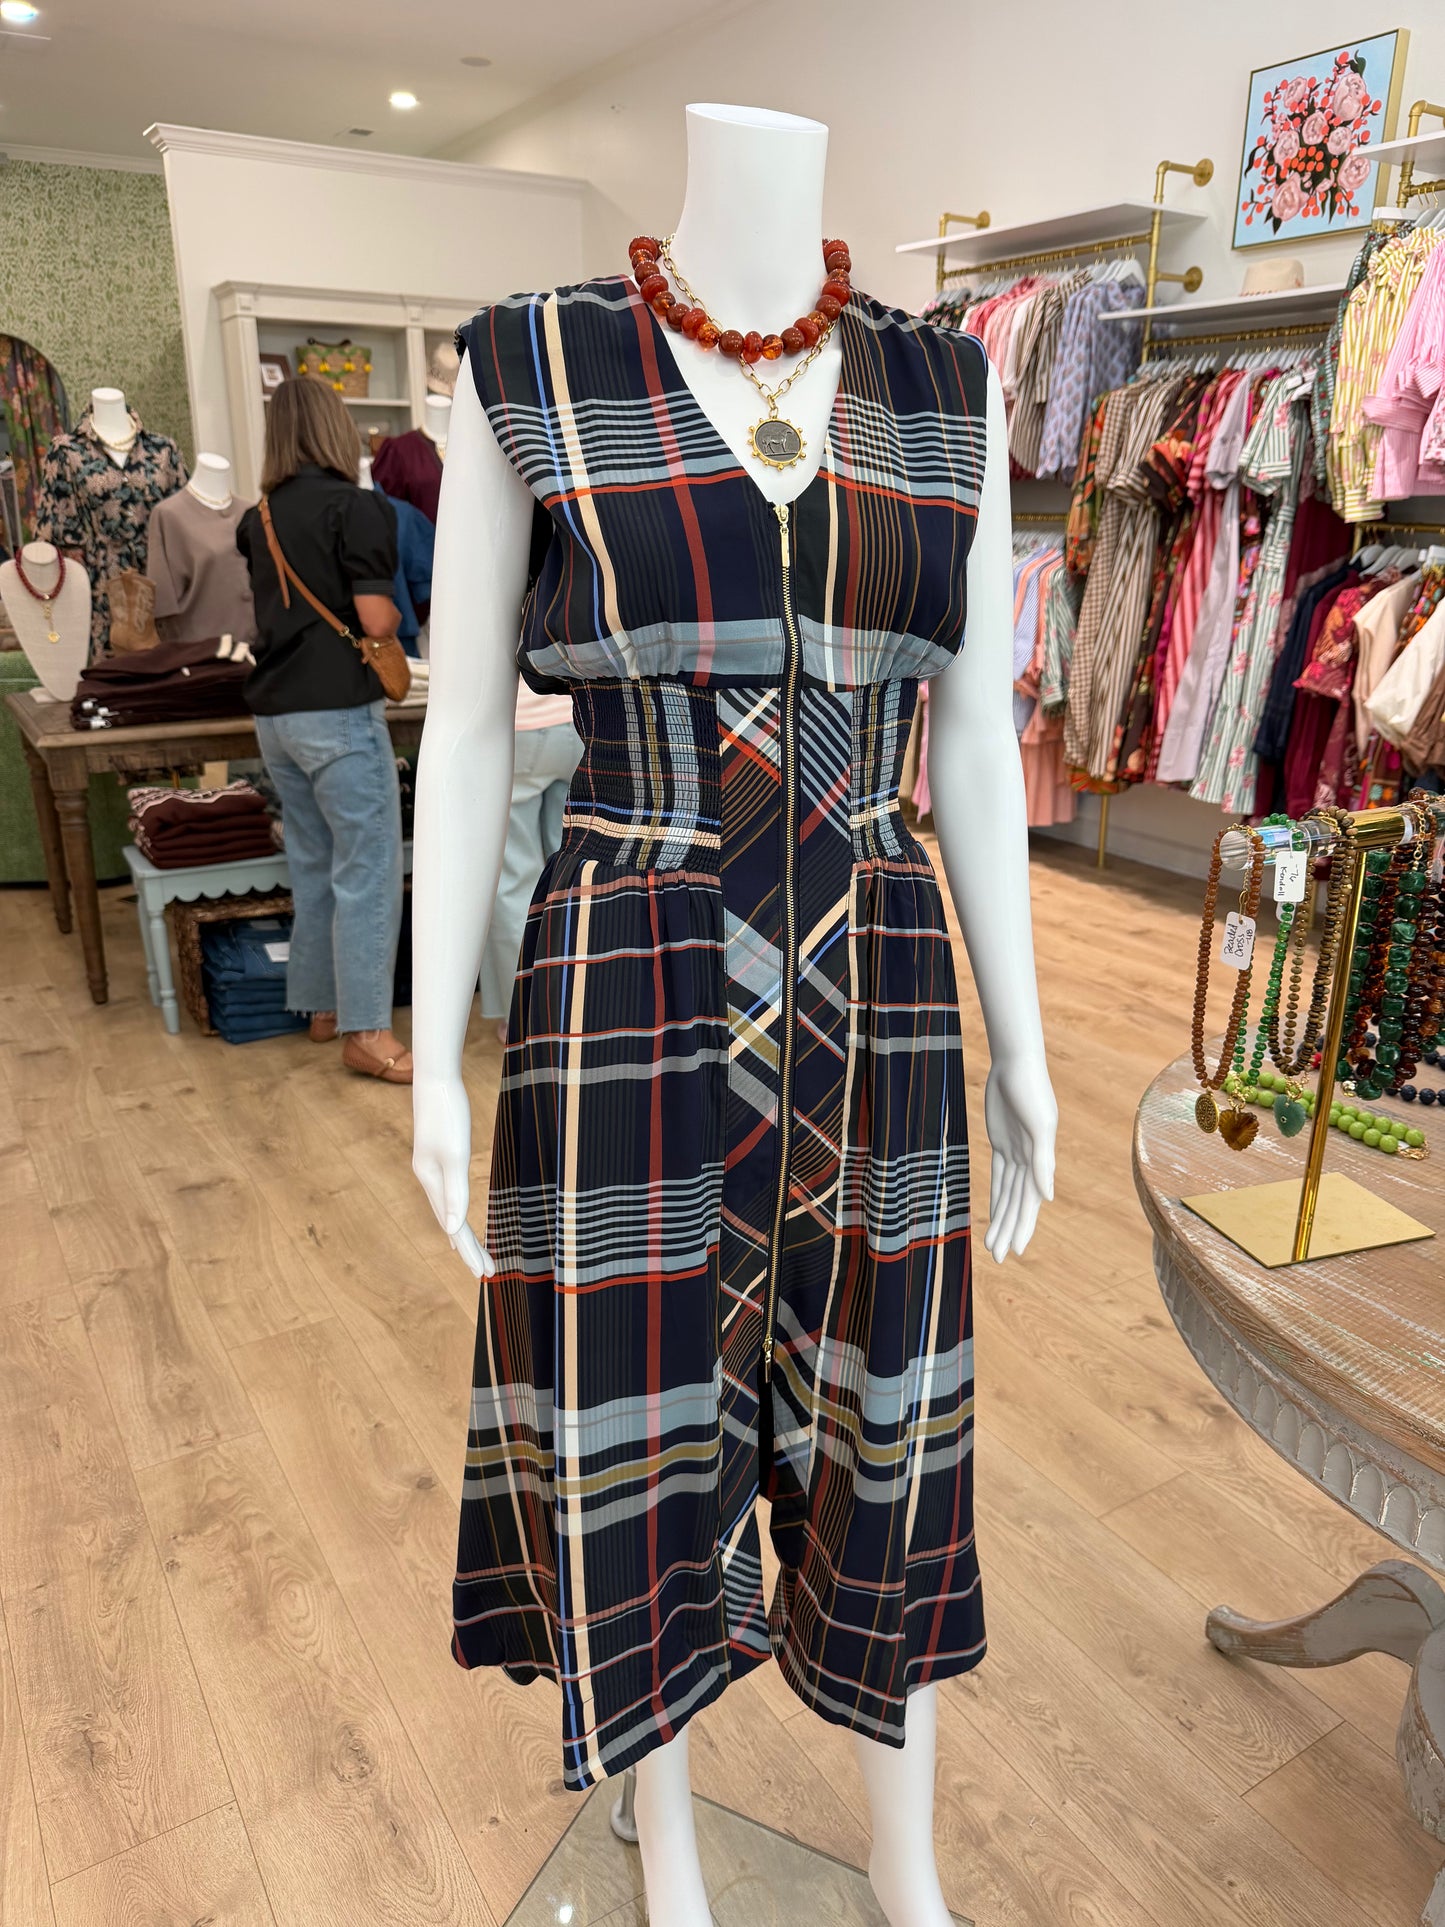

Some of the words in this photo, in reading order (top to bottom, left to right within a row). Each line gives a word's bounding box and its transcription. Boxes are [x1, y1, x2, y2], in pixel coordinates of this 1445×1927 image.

[1278, 866, 1287, 896] Kendall
[1223, 923, 1238, 954] Beaded
[1234, 933, 1245, 957] Cross
